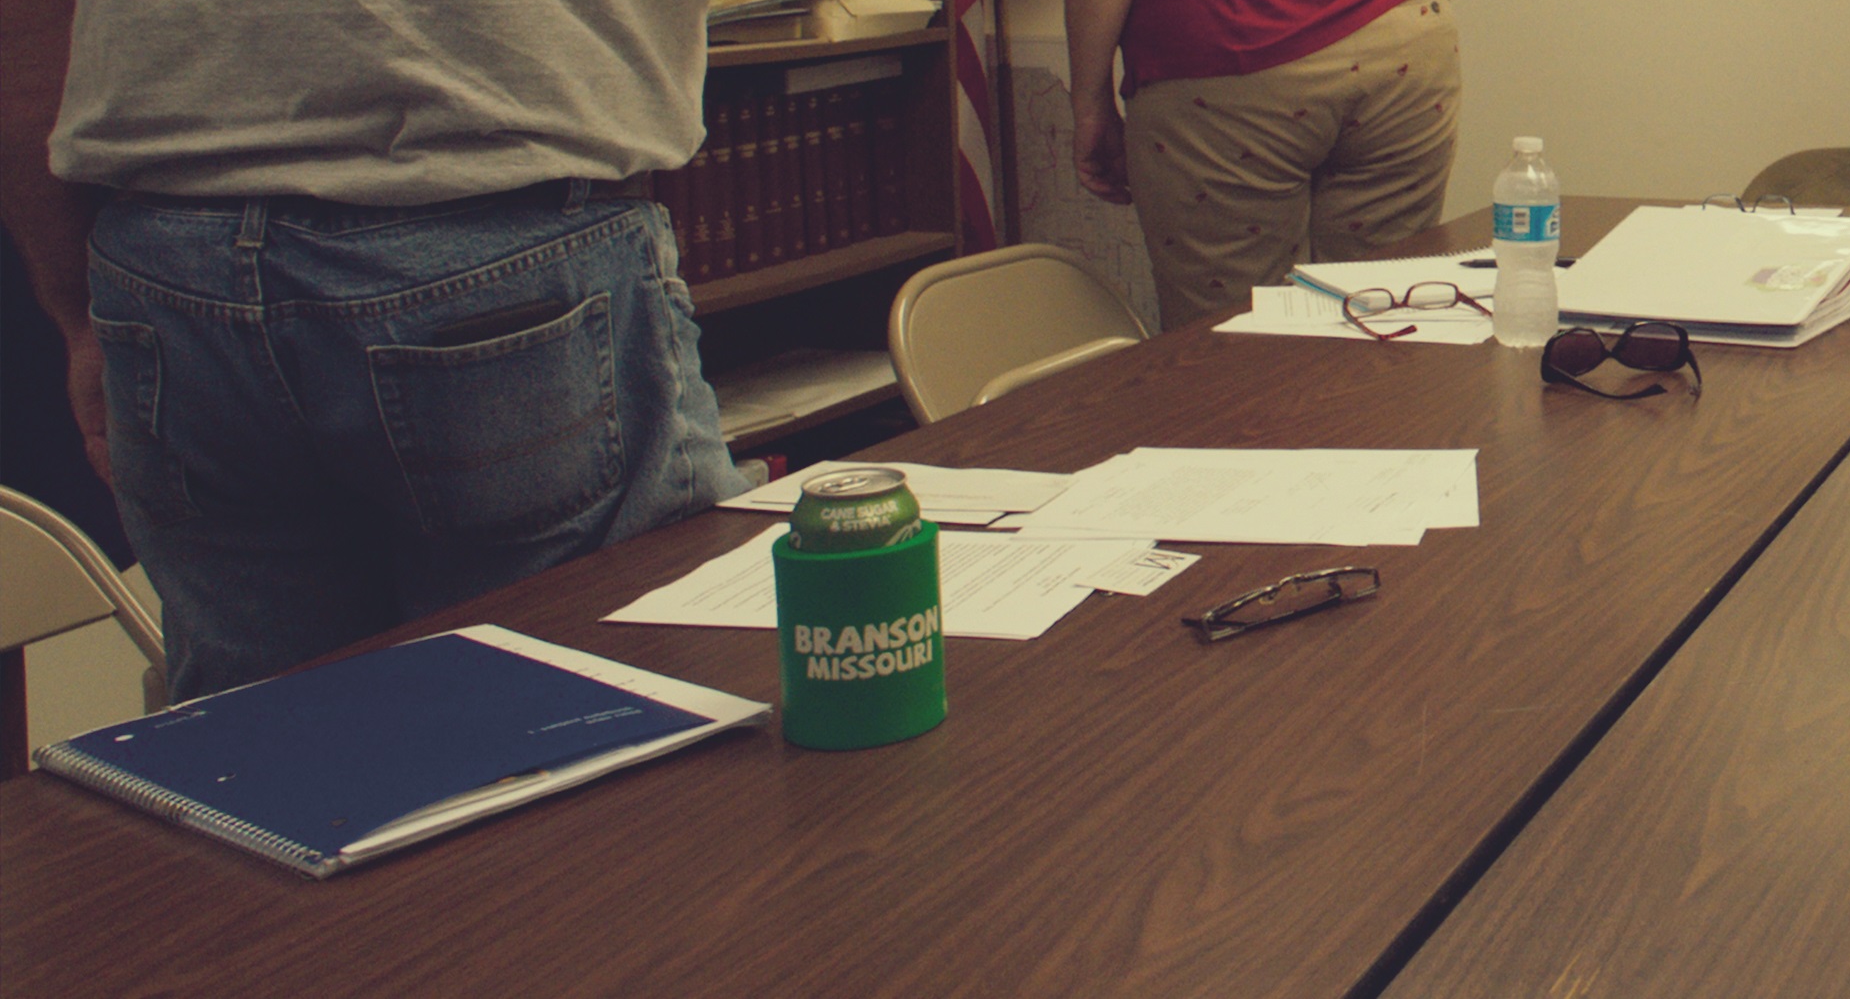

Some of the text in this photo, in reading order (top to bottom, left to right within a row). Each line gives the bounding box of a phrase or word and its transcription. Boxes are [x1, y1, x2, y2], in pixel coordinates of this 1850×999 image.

[821, 500, 898, 519] CANE SUGAR
[842, 516, 891, 531] STEVIA
[795, 605, 938, 655] BRANSON
[807, 639, 932, 681] MISSOURI
